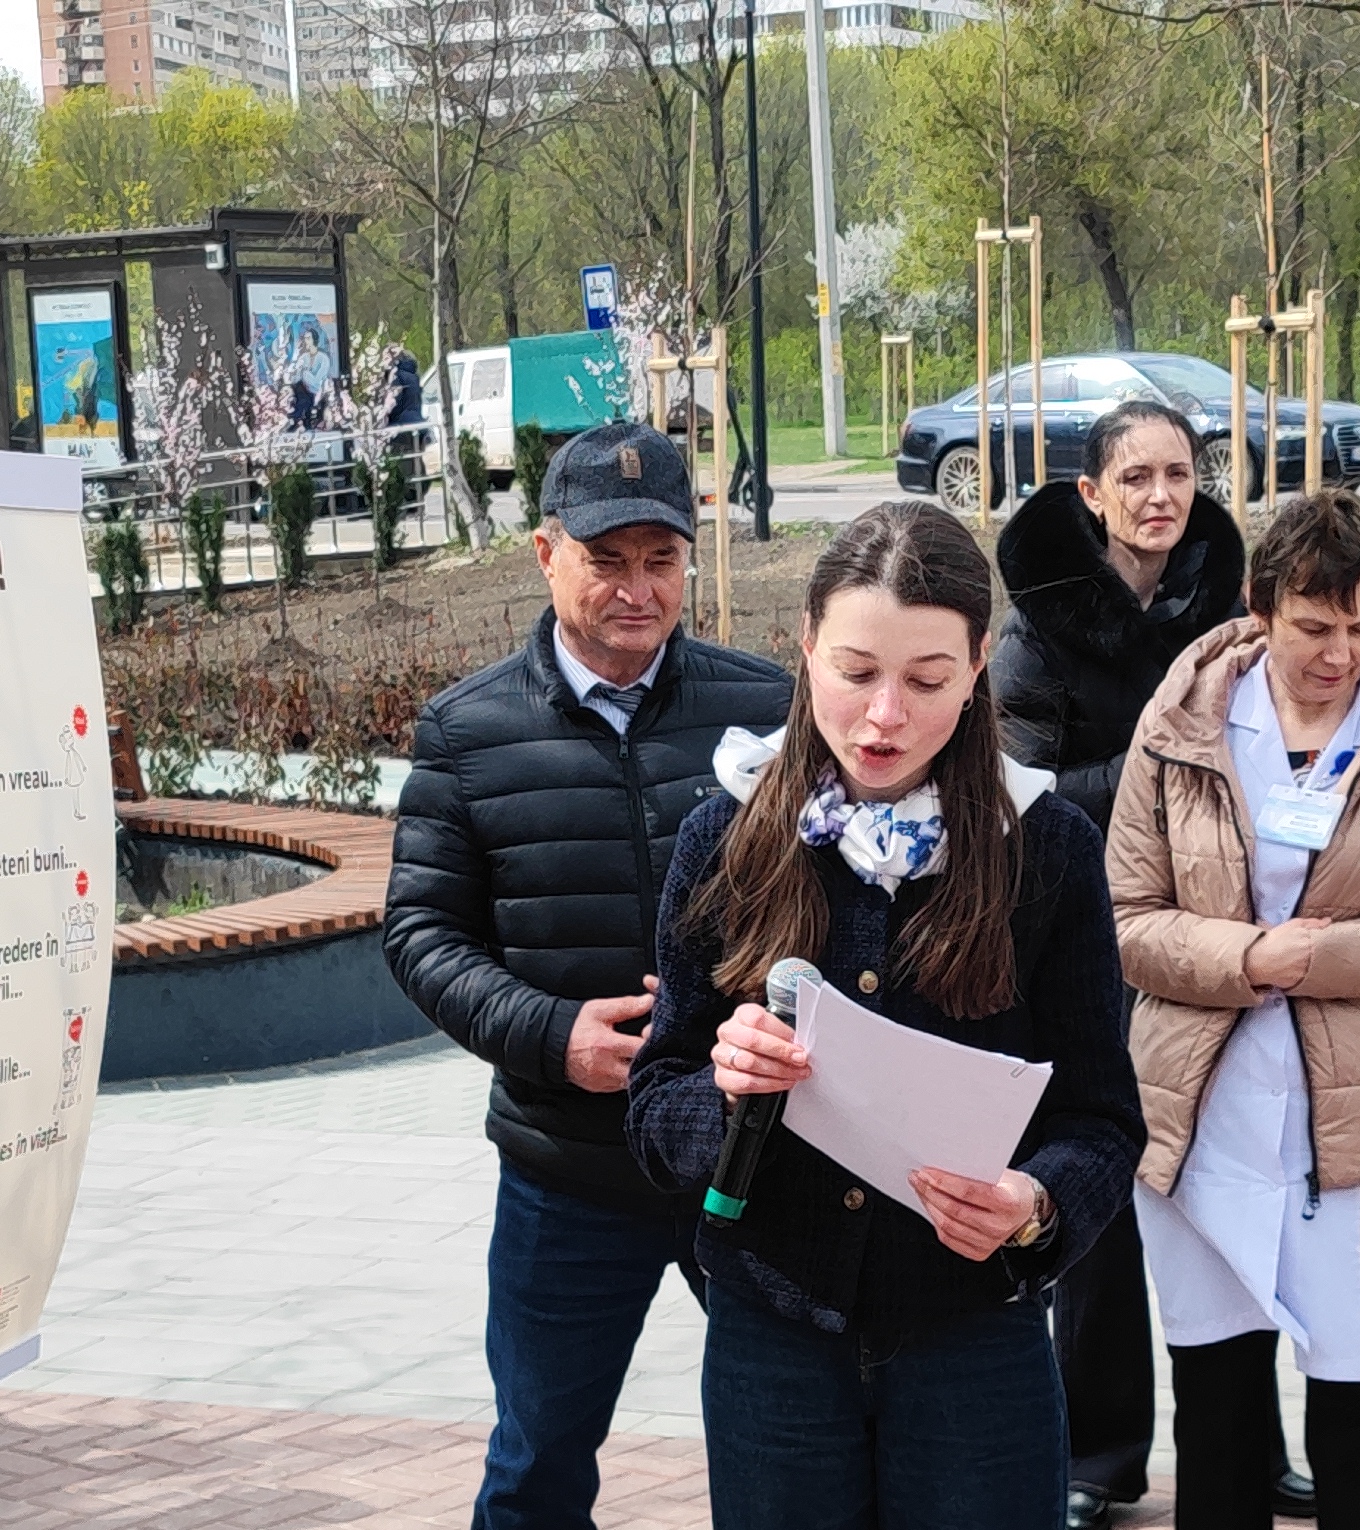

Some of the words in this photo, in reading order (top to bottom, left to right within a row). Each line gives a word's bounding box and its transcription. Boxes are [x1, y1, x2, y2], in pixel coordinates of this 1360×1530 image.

[9, 770, 62, 791] vreau...
[33, 845, 77, 872] buni...
[45, 932, 59, 957] în
[15, 1133, 28, 1158] în
